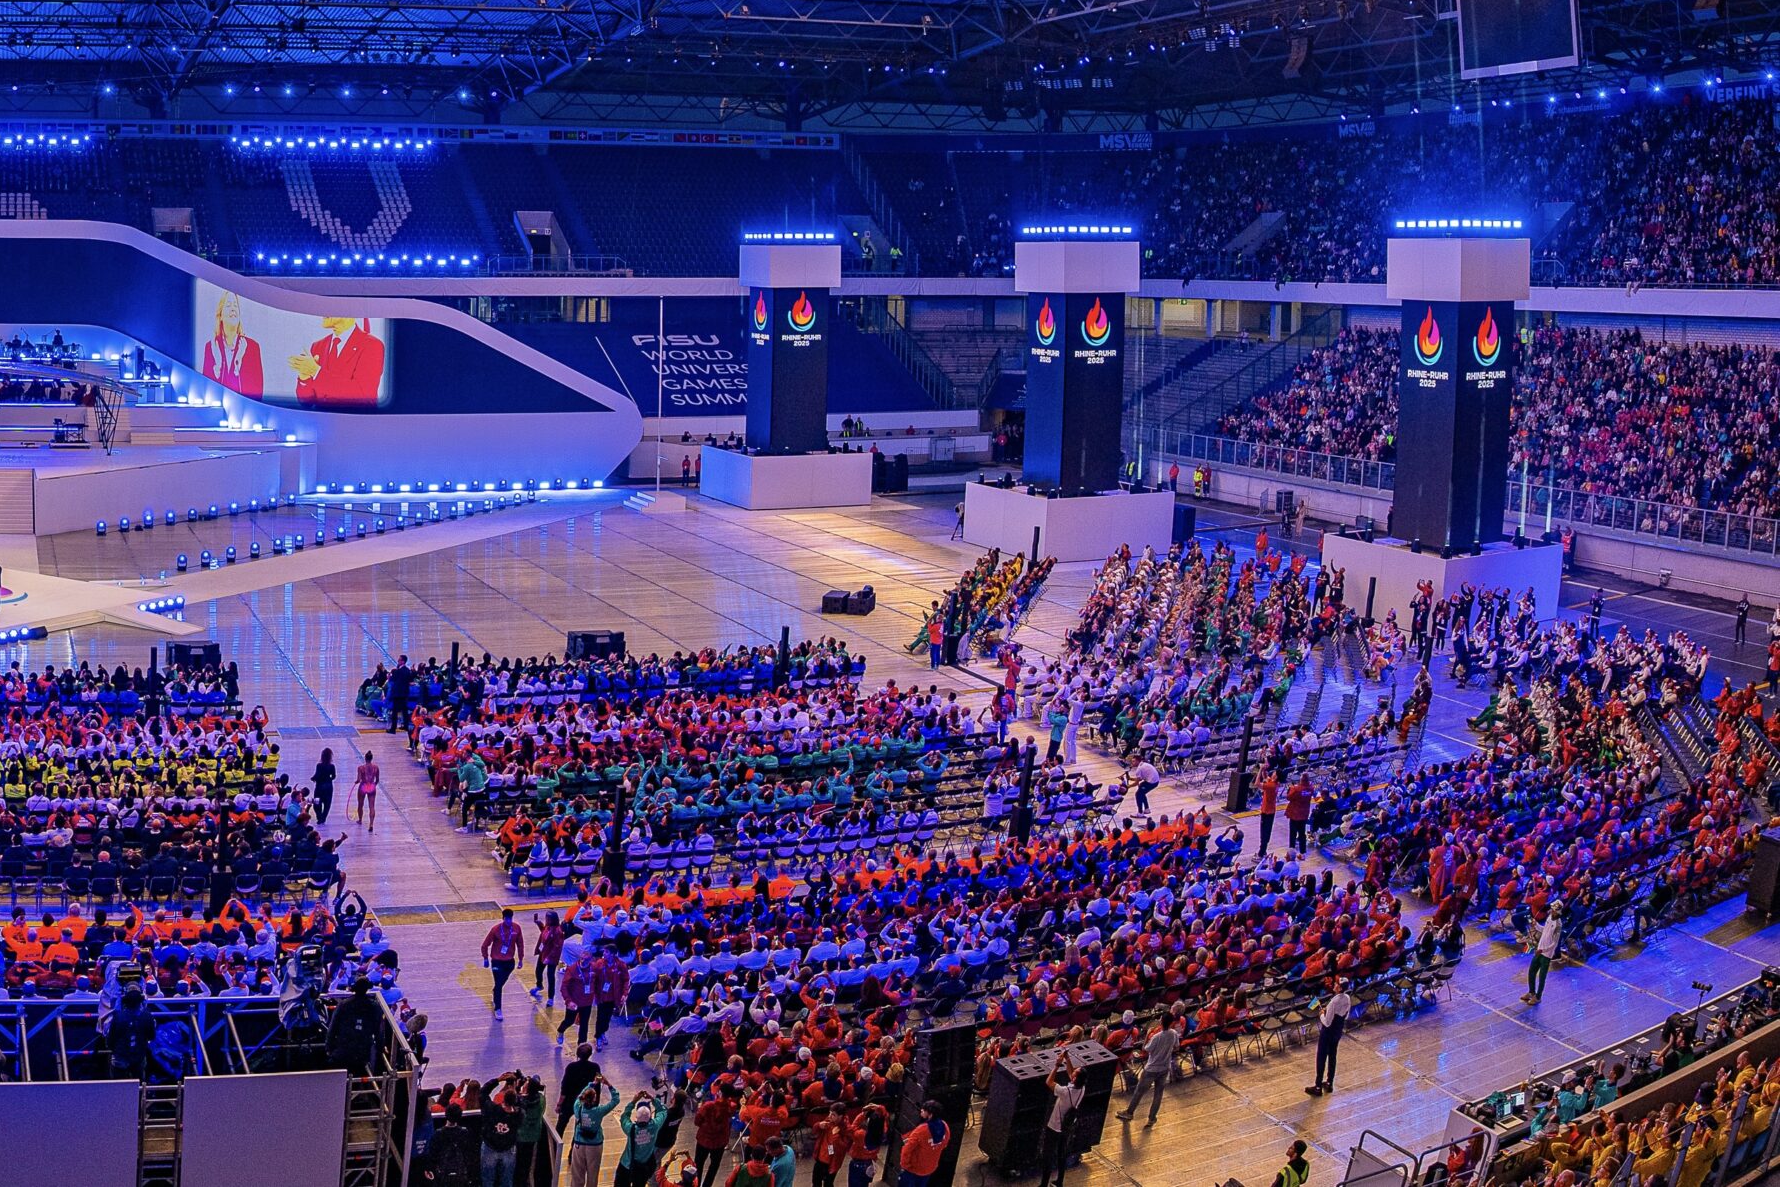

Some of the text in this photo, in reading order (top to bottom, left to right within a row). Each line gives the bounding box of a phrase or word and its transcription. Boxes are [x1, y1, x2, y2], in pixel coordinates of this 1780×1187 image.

[1338, 123, 1365, 138] MSV
[1099, 134, 1137, 149] MSV
[631, 334, 720, 346] FISU
[641, 349, 734, 361] WORLD
[1031, 347, 1060, 357] RHINE-RUHR
[1074, 349, 1117, 358] RHINE-RUHR
[1039, 356, 1052, 364] 2025
[651, 363, 748, 375] UNIVERS
[1407, 369, 1449, 380] RHINE-RUHR
[1466, 370, 1506, 381] RHINE-RUHR
[662, 378, 748, 390] GAMES
[1419, 379, 1437, 388] 2025
[1477, 380, 1495, 389] 2025
[670, 394, 748, 406] SUMM
